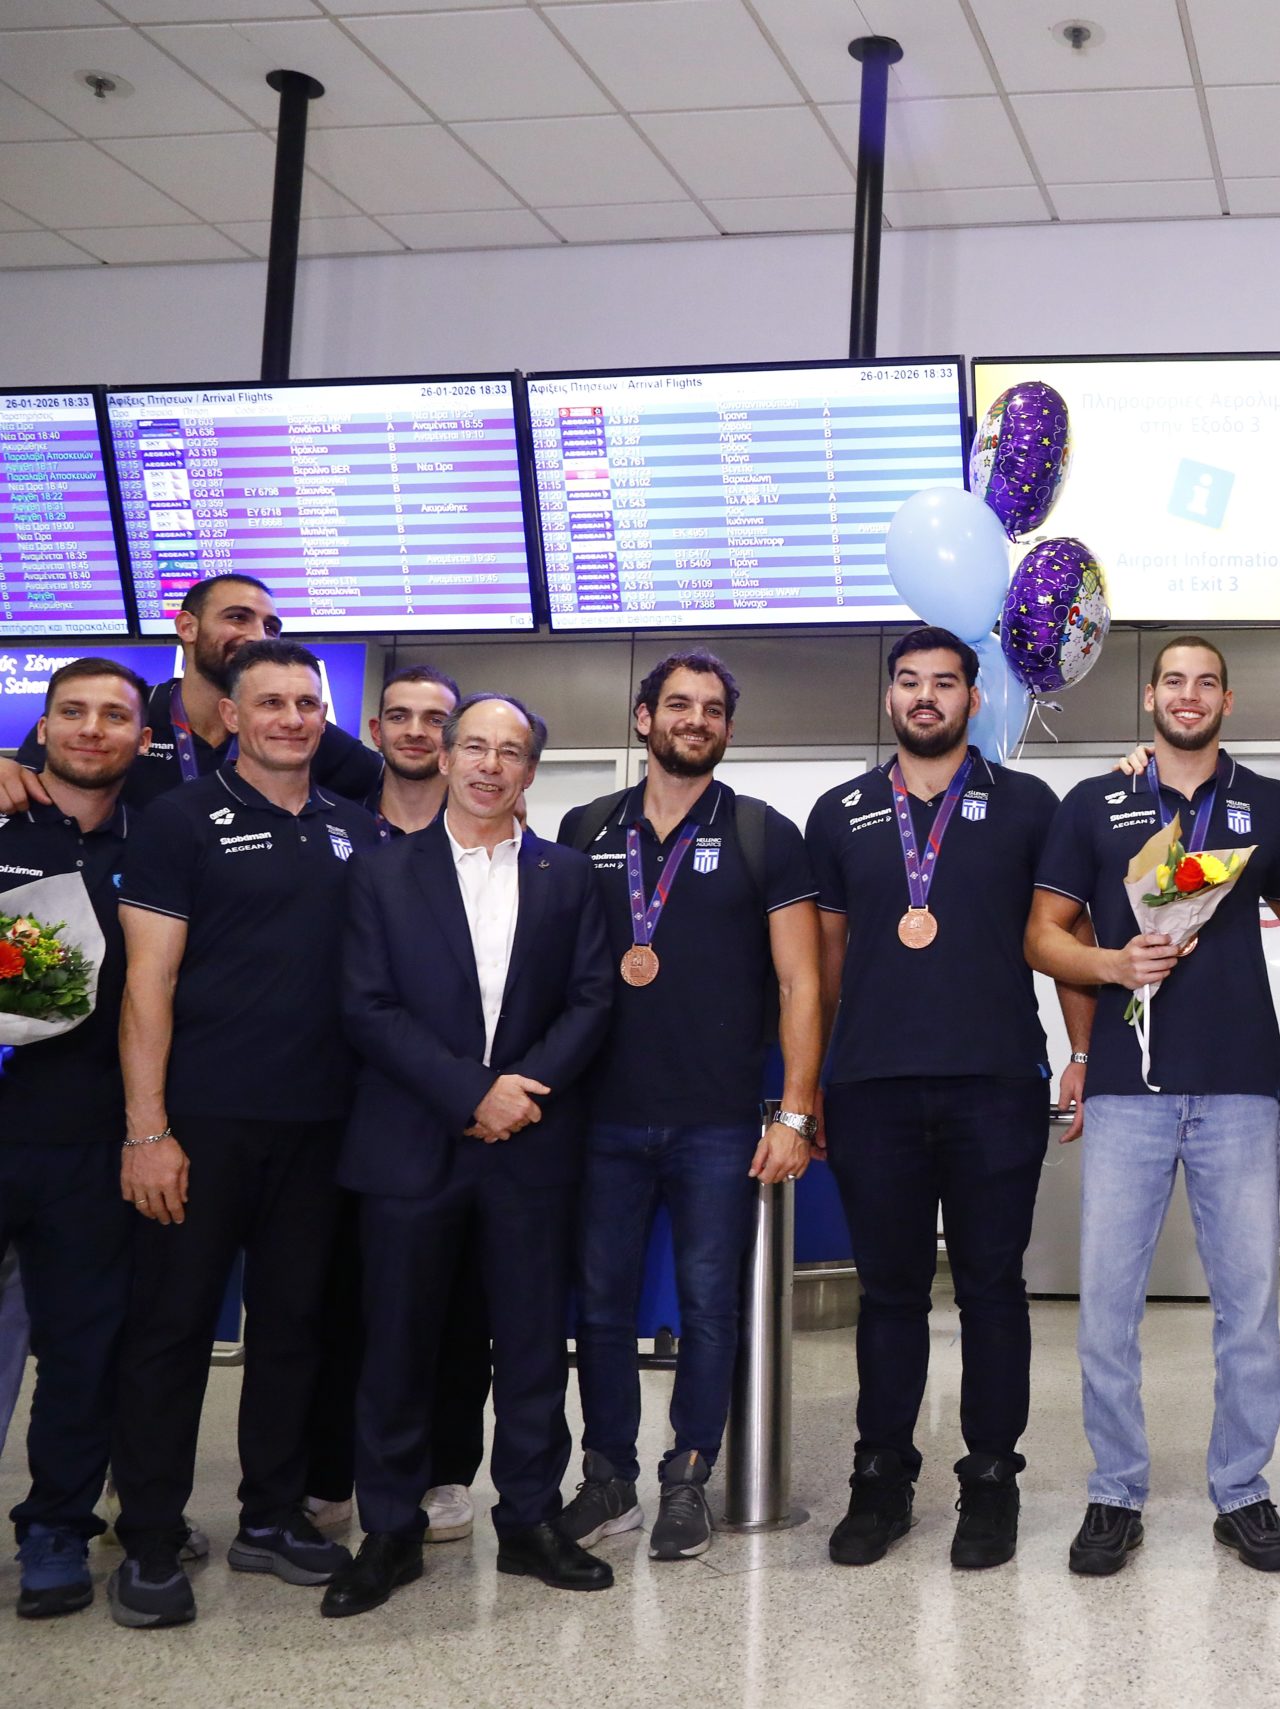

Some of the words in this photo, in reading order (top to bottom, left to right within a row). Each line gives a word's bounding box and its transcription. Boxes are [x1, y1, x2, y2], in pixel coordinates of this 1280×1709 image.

[861, 369, 920, 381] 26-01-2026
[924, 368, 953, 379] 18:33
[421, 386, 476, 397] 26-01-2026
[480, 384, 507, 395] 18:33
[529, 383, 568, 395] Αφίξεις
[628, 379, 663, 390] Arrival
[666, 378, 703, 390] Flights
[6, 398, 60, 409] 26-01-2026
[63, 397, 90, 407] 18:33
[109, 396, 145, 408] Αφίξεις
[147, 394, 193, 406] Πτήσεων
[202, 393, 236, 403] Arrival
[239, 392, 273, 404] Flights
[531, 418, 555, 428] 20:50
[608, 415, 621, 425] A3
[623, 414, 640, 424] 973
[1249, 416, 1261, 433] 3
[113, 430, 134, 439] 19:10
[185, 428, 199, 437] BA
[199, 428, 215, 437] 636
[322, 423, 342, 433] LHR
[460, 419, 484, 429] 18:55
[38, 431, 61, 440] 18:40
[533, 439, 557, 449] 21:00
[610, 437, 623, 446] A3
[47, 450, 94, 460] Αποσκευών
[115, 450, 137, 459] 19:15
[143, 450, 175, 458] AEGEAN
[188, 448, 200, 458] A3
[202, 448, 217, 457] 319
[144, 460, 177, 468] AEGEAN
[535, 460, 560, 470] 21:05
[49, 471, 97, 481] Αποσκευών
[118, 470, 140, 480] 19:25
[191, 469, 206, 478] GQ
[207, 468, 223, 478] 875
[330, 464, 351, 474] BER
[538, 480, 562, 490] 21:15
[614, 478, 627, 488] VY
[41, 491, 64, 501] 18:22
[121, 490, 143, 500] 19:25
[194, 489, 208, 499] GQ
[209, 488, 225, 498] 421
[244, 488, 257, 497] EY
[151, 500, 182, 508] AEGEAN
[540, 501, 563, 511] 21:20
[616, 498, 628, 508] LY
[630, 498, 646, 508] 543
[761, 493, 780, 504] TLV
[44, 511, 67, 521] 18:29
[124, 511, 146, 520] 19:35
[196, 509, 211, 519] GQ
[212, 508, 229, 518] 345
[247, 508, 260, 518] EY
[261, 507, 282, 517] 6718
[542, 521, 566, 531] 21:25
[127, 530, 149, 540] 19:45
[155, 530, 186, 539] AEGEAN
[200, 529, 212, 538] A3
[212, 529, 227, 538] 257
[544, 542, 568, 552] 21:30
[66, 550, 88, 560] 18:35
[130, 550, 152, 559] 19:55
[158, 550, 189, 559] AEGEAN
[202, 549, 214, 558] A3
[215, 549, 231, 558] 913
[546, 563, 570, 572] 21:35
[675, 559, 688, 569] BT
[689, 559, 712, 569] 5409
[1116, 550, 1177, 573] Airport
[69, 571, 91, 581] 18:40
[160, 571, 192, 579] AEGEAN
[205, 569, 217, 578] A3
[548, 583, 572, 592] 21:40
[624, 581, 637, 590] A3
[677, 580, 690, 589] V7
[691, 579, 713, 589] 5109
[1167, 577, 1185, 592] at
[1190, 575, 1223, 592] Exit
[1229, 575, 1240, 592] 3
[136, 590, 158, 600] 20:40
[550, 603, 574, 613] 21:55
[626, 601, 639, 611] A3
[680, 600, 692, 610] TP
[694, 600, 716, 609] 7388
[733, 599, 768, 610] Μόναχο
[554, 614, 578, 627] your
[580, 613, 625, 627] personal
[627, 612, 683, 627] belongings
[48, 622, 63, 632] και
[852, 818, 885, 833] AEGEAN
[1112, 818, 1148, 830] AEGEAN
[224, 842, 265, 854] AEGEAN
[0, 863, 44, 877] oiximan
